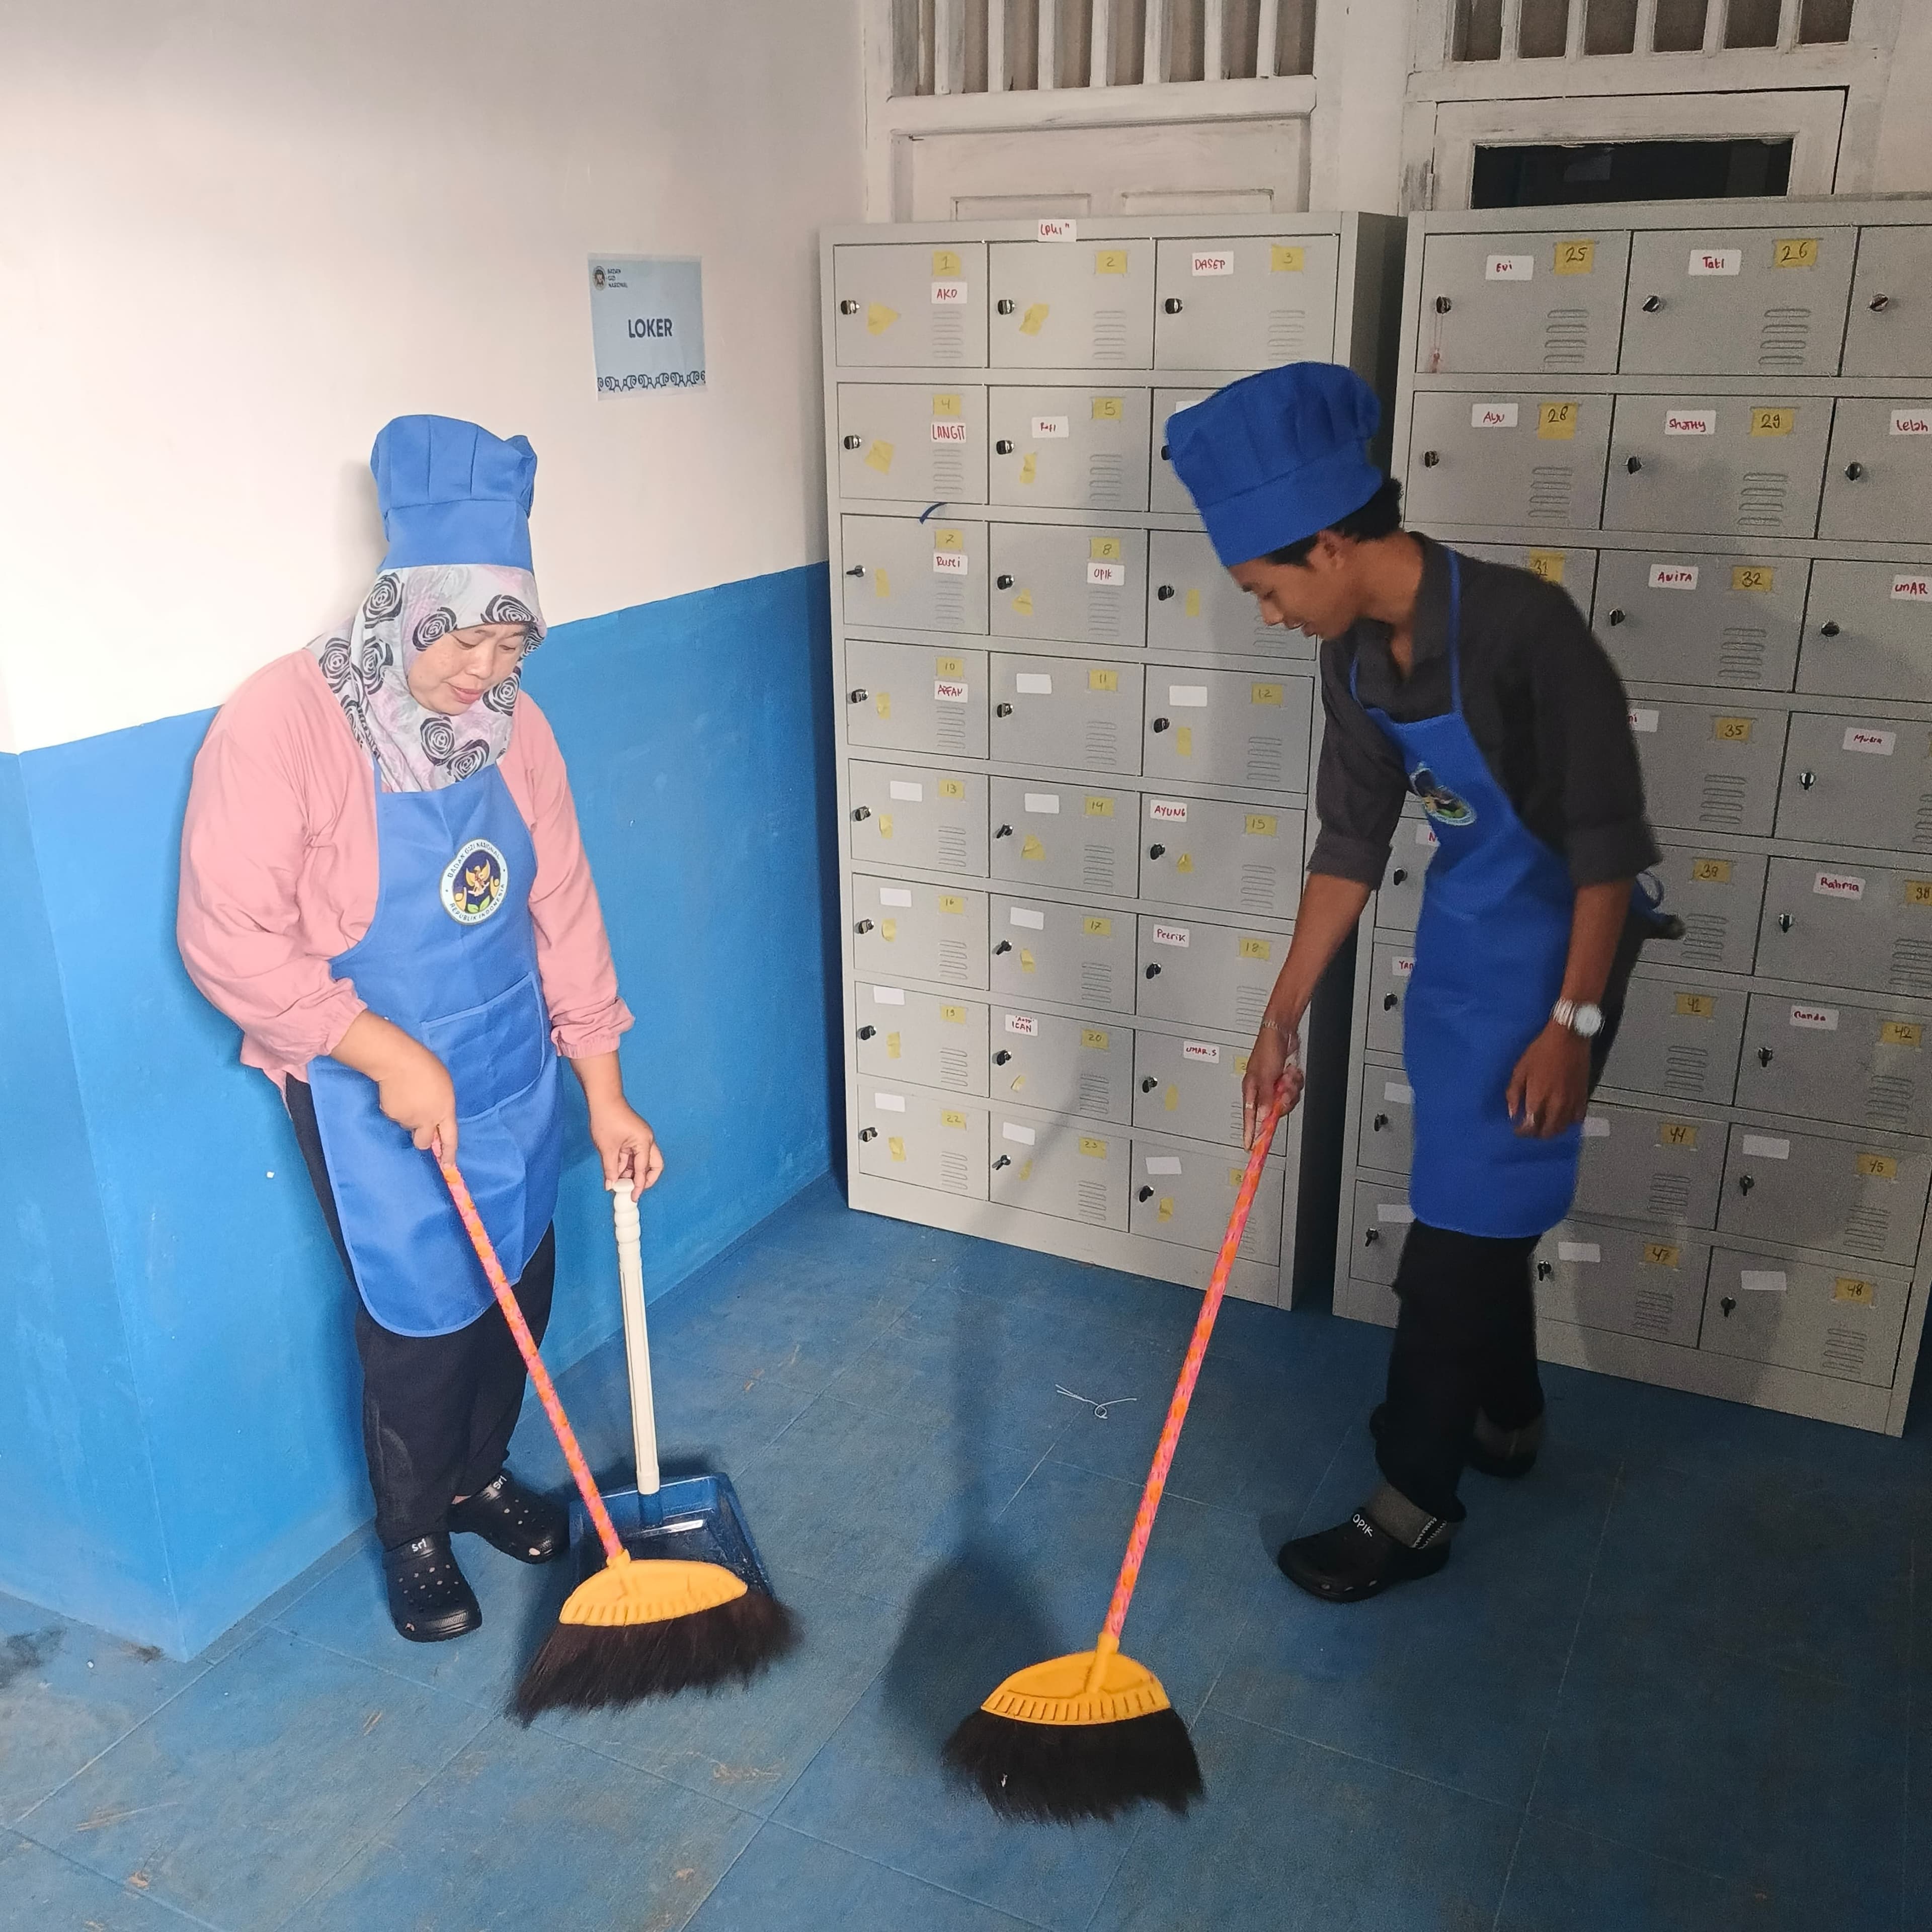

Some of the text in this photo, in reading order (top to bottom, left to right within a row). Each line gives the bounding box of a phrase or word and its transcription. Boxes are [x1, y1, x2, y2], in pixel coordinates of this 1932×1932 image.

[1566, 247, 1587, 262] 25
[1781, 242, 1808, 262] 26
[941, 256, 954, 270] 1
[1106, 257, 1114, 267] 2
[1195, 259, 1225, 270] DASEP
[1284, 253, 1293, 264] 3
[937, 288, 957, 299] AKO
[628, 318, 673, 338] LOKER
[941, 398, 950, 410] 4
[1104, 403, 1115, 416] 5
[1548, 406, 1568, 423] 28
[933, 425, 964, 440] LANGIT
[1103, 544, 1112, 554] 8
[1742, 571, 1762, 586] 32
[945, 663, 955, 671] 10
[1100, 674, 1106, 683] 11
[1725, 724, 1742, 737] 35
[946, 784, 956, 794] 13
[1091, 802, 1103, 811] 14
[1154, 806, 1185, 817] AYUNG
[1252, 820, 1265, 830] 15
[450, 903, 477, 921] REPUBLIK
[1090, 921, 1101, 930] 17
[1157, 929, 1185, 942] Petrik
[1012, 1021, 1031, 1032] ICAN
[1088, 1033, 1102, 1042] 20
[1670, 1128, 1685, 1142] 44
[1871, 1161, 1883, 1173] 45
[1652, 1248, 1669, 1262] 47
[1847, 1283, 1862, 1297] 48
[1353, 1514, 1373, 1537] OPIK
